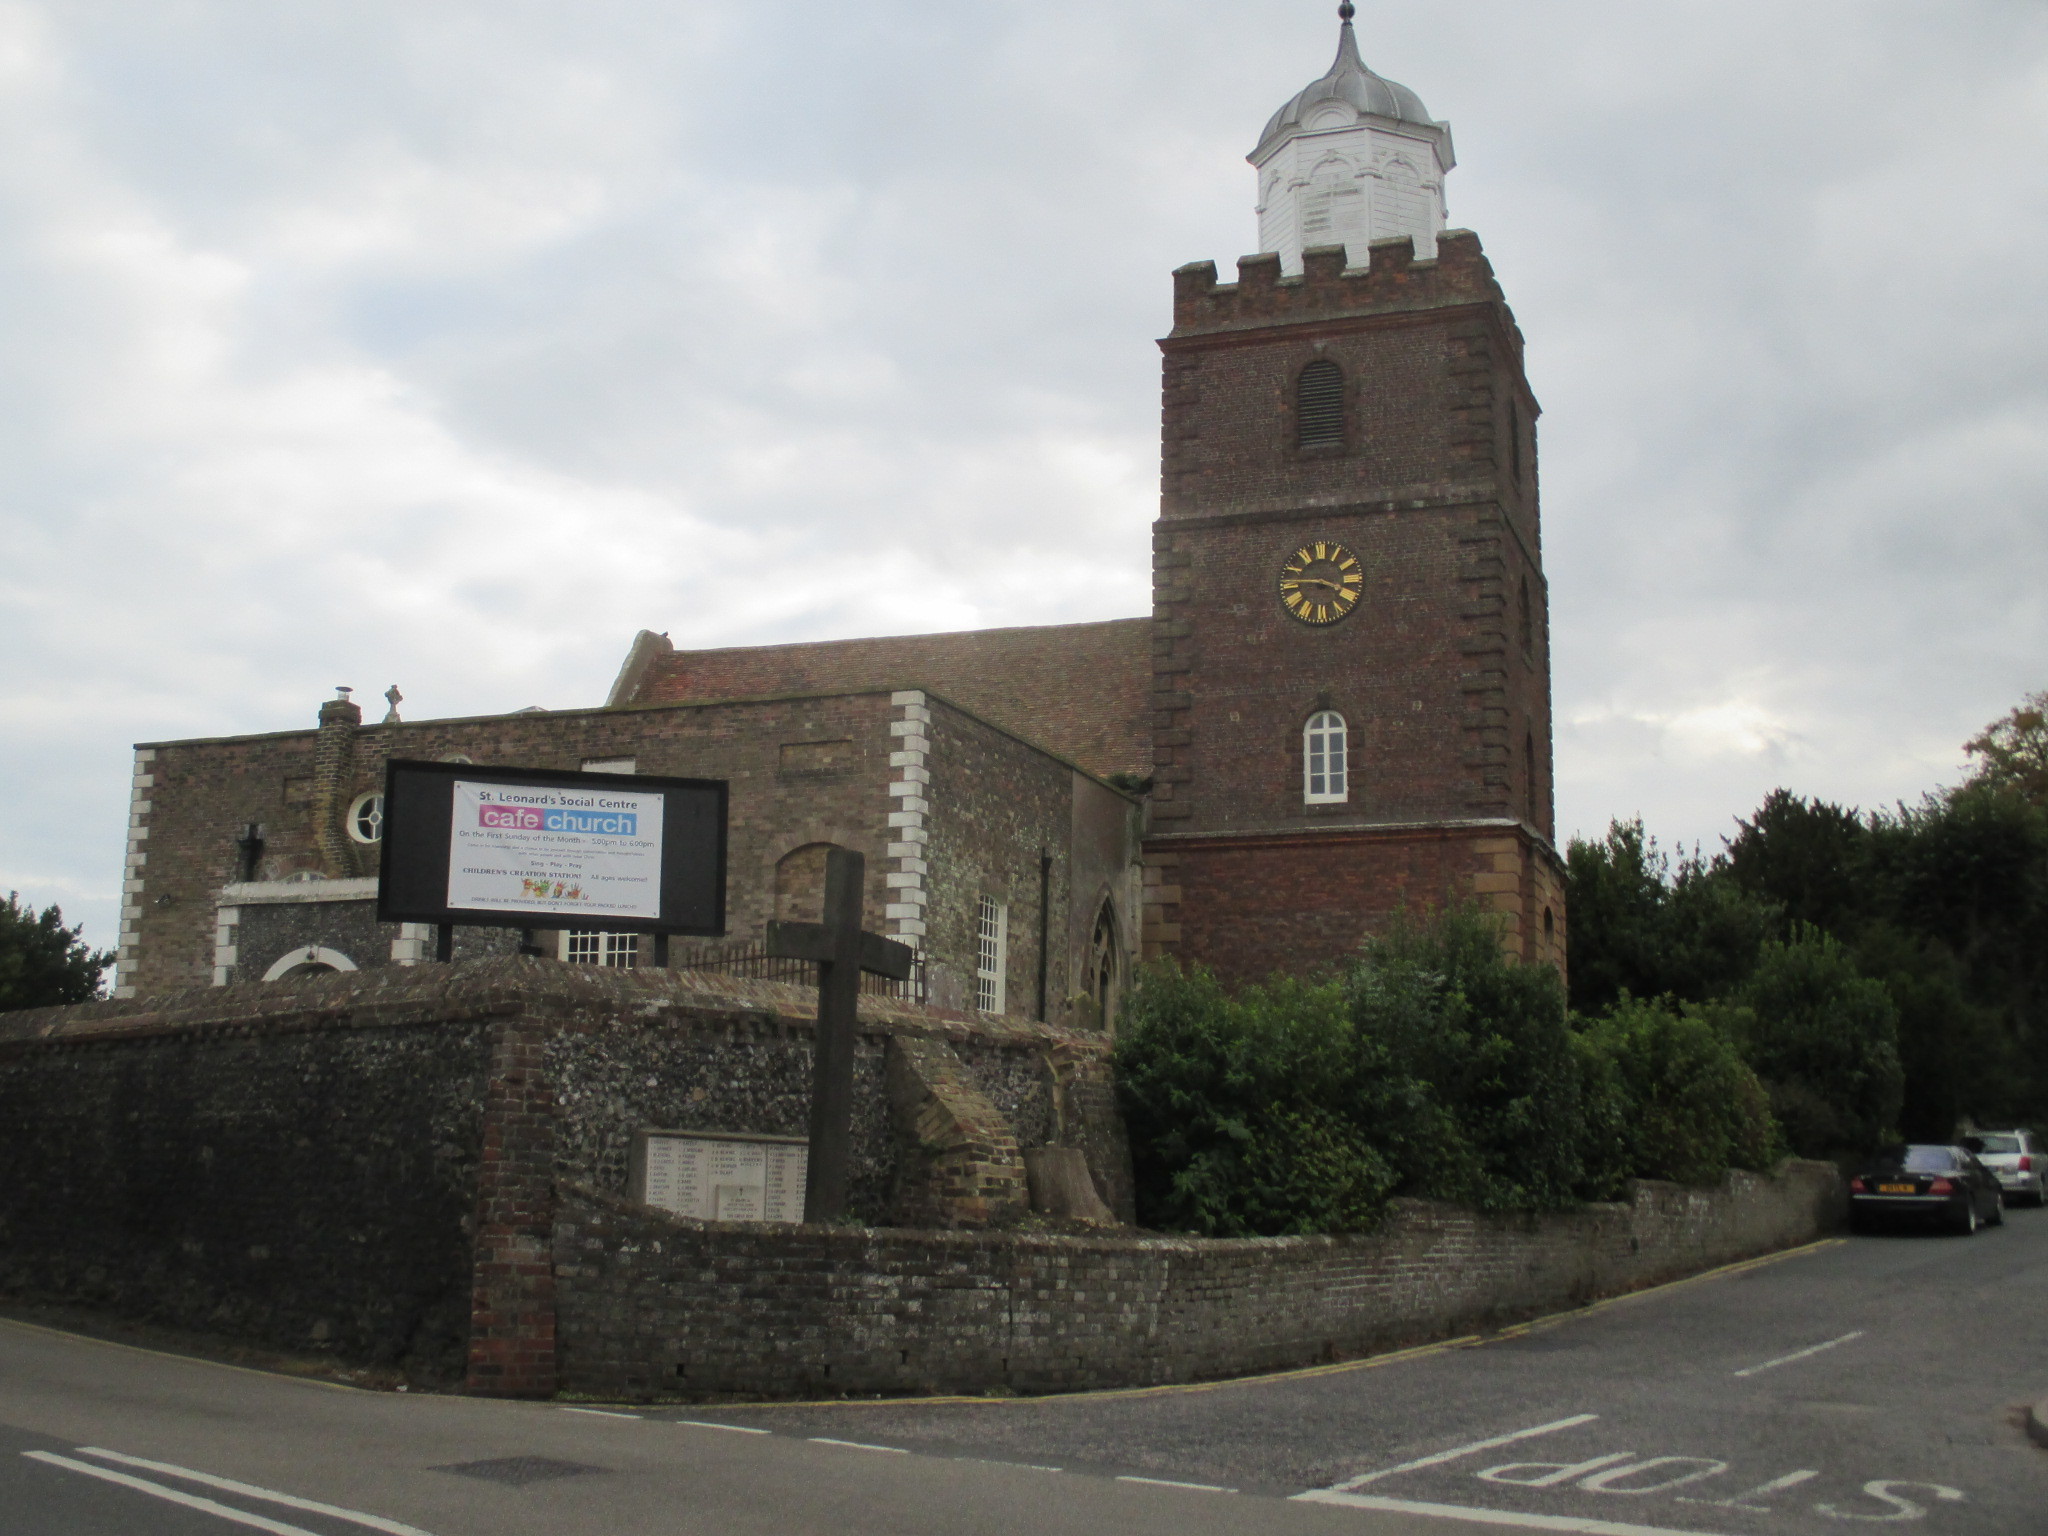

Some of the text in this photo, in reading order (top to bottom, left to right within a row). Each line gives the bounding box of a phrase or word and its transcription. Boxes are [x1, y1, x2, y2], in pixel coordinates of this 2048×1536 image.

[479, 791, 638, 810] St. Leonard's Social Centre
[484, 809, 632, 834] cafe church
[486, 831, 502, 839] First
[504, 832, 531, 842] Sunday
[532, 834, 541, 842] of
[557, 836, 581, 844] Month
[462, 867, 508, 876] CHILDREN'S
[509, 869, 547, 878] CREATION
[550, 861, 563, 869] Play
[568, 862, 582, 870] Pray
[1477, 1452, 1965, 1520] STOP
